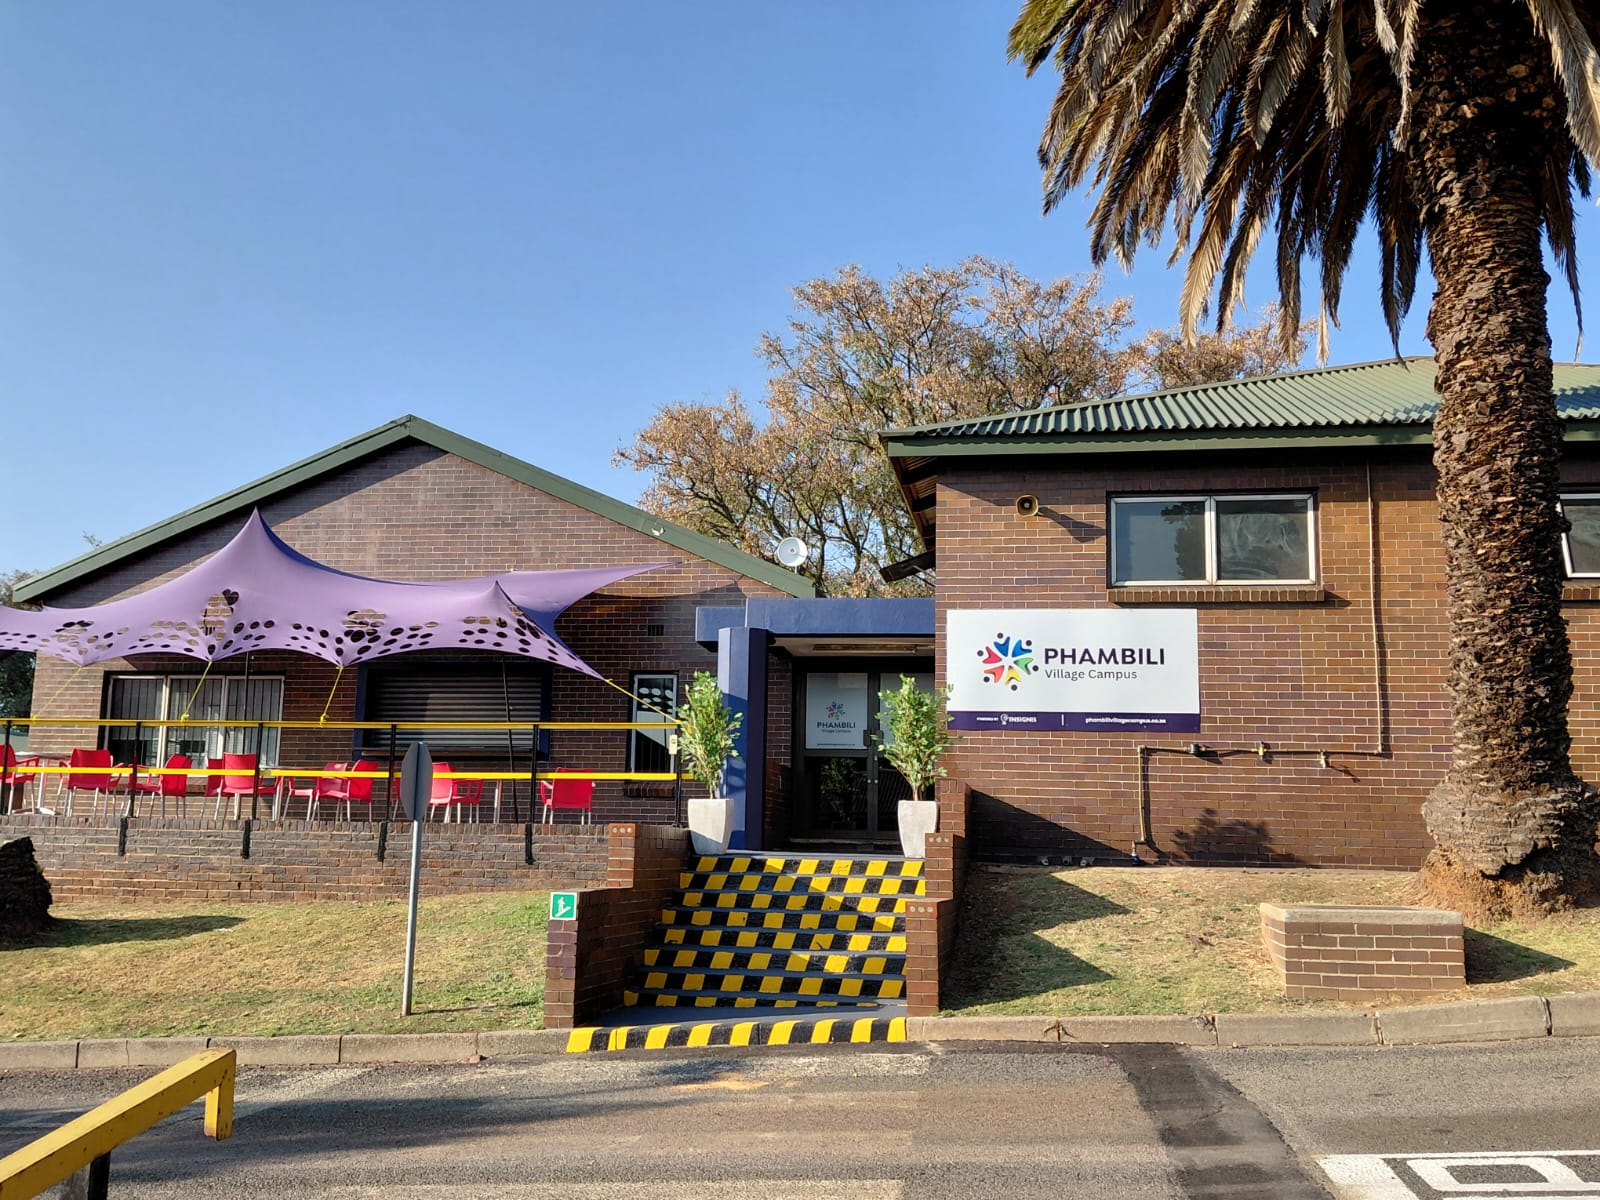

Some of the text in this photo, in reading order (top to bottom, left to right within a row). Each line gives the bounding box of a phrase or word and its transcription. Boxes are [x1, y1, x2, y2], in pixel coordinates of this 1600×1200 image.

[1044, 648, 1165, 665] PHAMBILI
[1045, 669, 1138, 682] Village Campus
[816, 721, 856, 729] PHAMBILI
